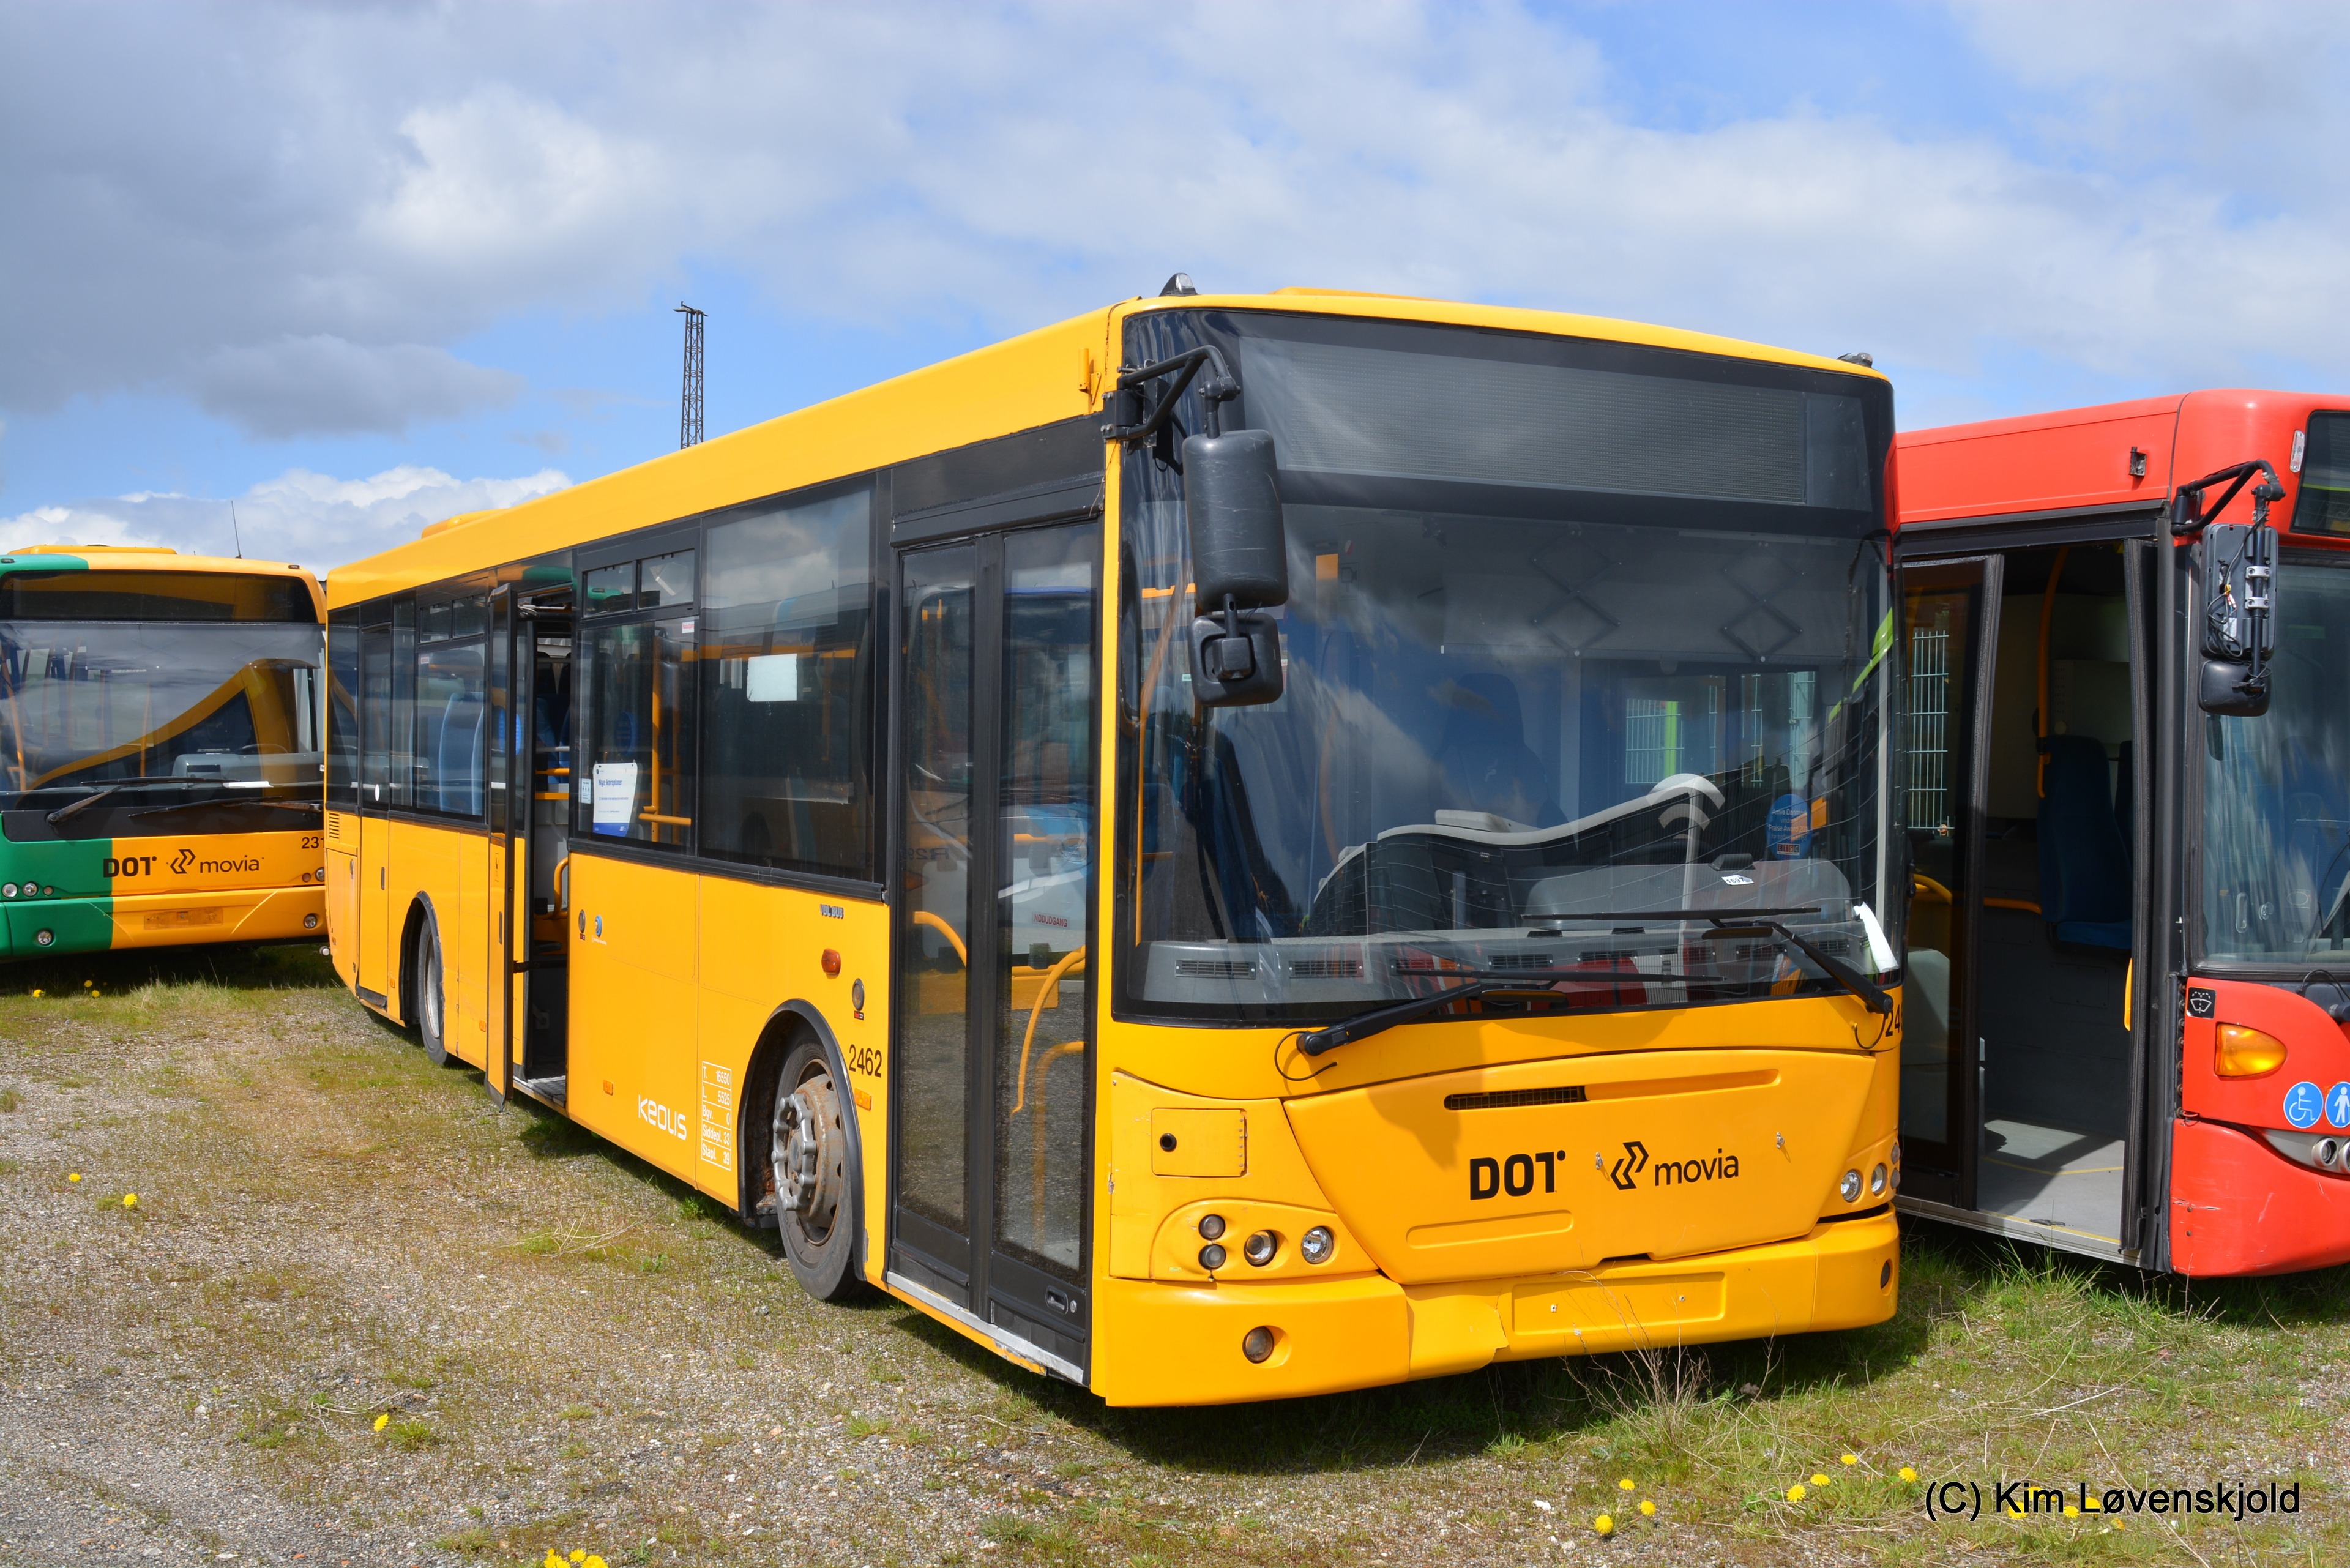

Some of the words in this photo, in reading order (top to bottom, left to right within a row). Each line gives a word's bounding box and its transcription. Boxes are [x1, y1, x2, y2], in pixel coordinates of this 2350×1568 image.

[103, 856, 157, 878] DOT
[200, 854, 259, 873] movia
[1886, 1004, 1901, 1037] 24
[849, 1043, 882, 1078] 2462
[716, 1070, 730, 1085] 16550
[717, 1091, 730, 1106] 5525
[703, 1105, 714, 1121] Bgv.
[702, 1124, 722, 1144] Siddepl.
[723, 1132, 730, 1146] 33
[723, 1151, 730, 1165] 39
[1470, 1149, 1565, 1200] DOT
[1654, 1148, 1739, 1187] movia
